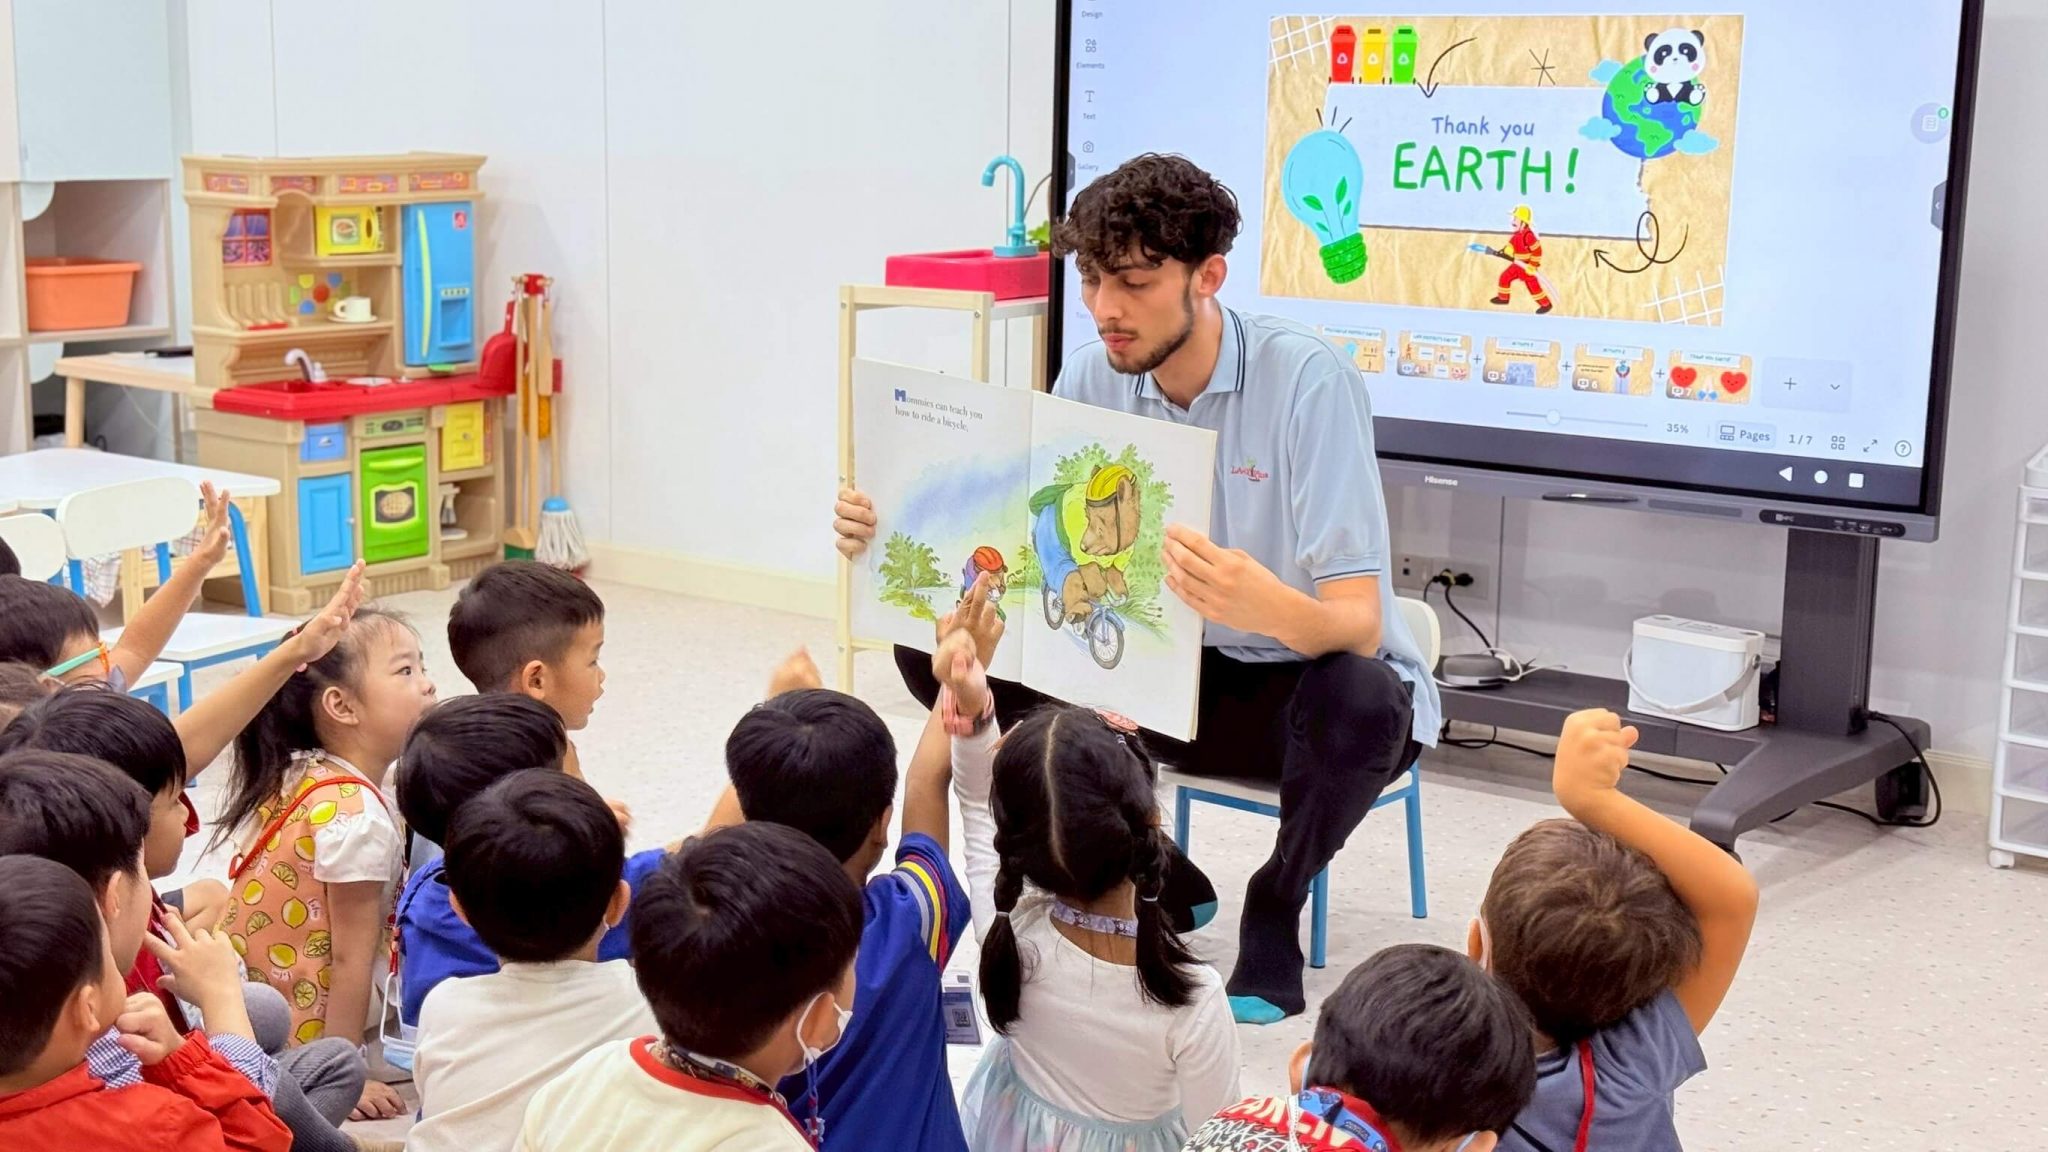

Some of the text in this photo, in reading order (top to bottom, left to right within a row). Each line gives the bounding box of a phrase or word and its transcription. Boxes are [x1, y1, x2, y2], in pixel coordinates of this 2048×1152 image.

[1082, 10, 1103, 19] Design
[1432, 115, 1535, 142] Thank you
[1394, 142, 1579, 195] EARTH!
[1591, 381, 1598, 389] 6
[894, 389, 983, 420] Mommies can teach you
[895, 405, 910, 416] how
[912, 410, 920, 419] to
[921, 412, 936, 423] ride
[936, 417, 942, 425] a
[1666, 423, 1689, 434] 35%
[1739, 428, 1771, 444] Pages
[1424, 475, 1458, 486] Hisense
